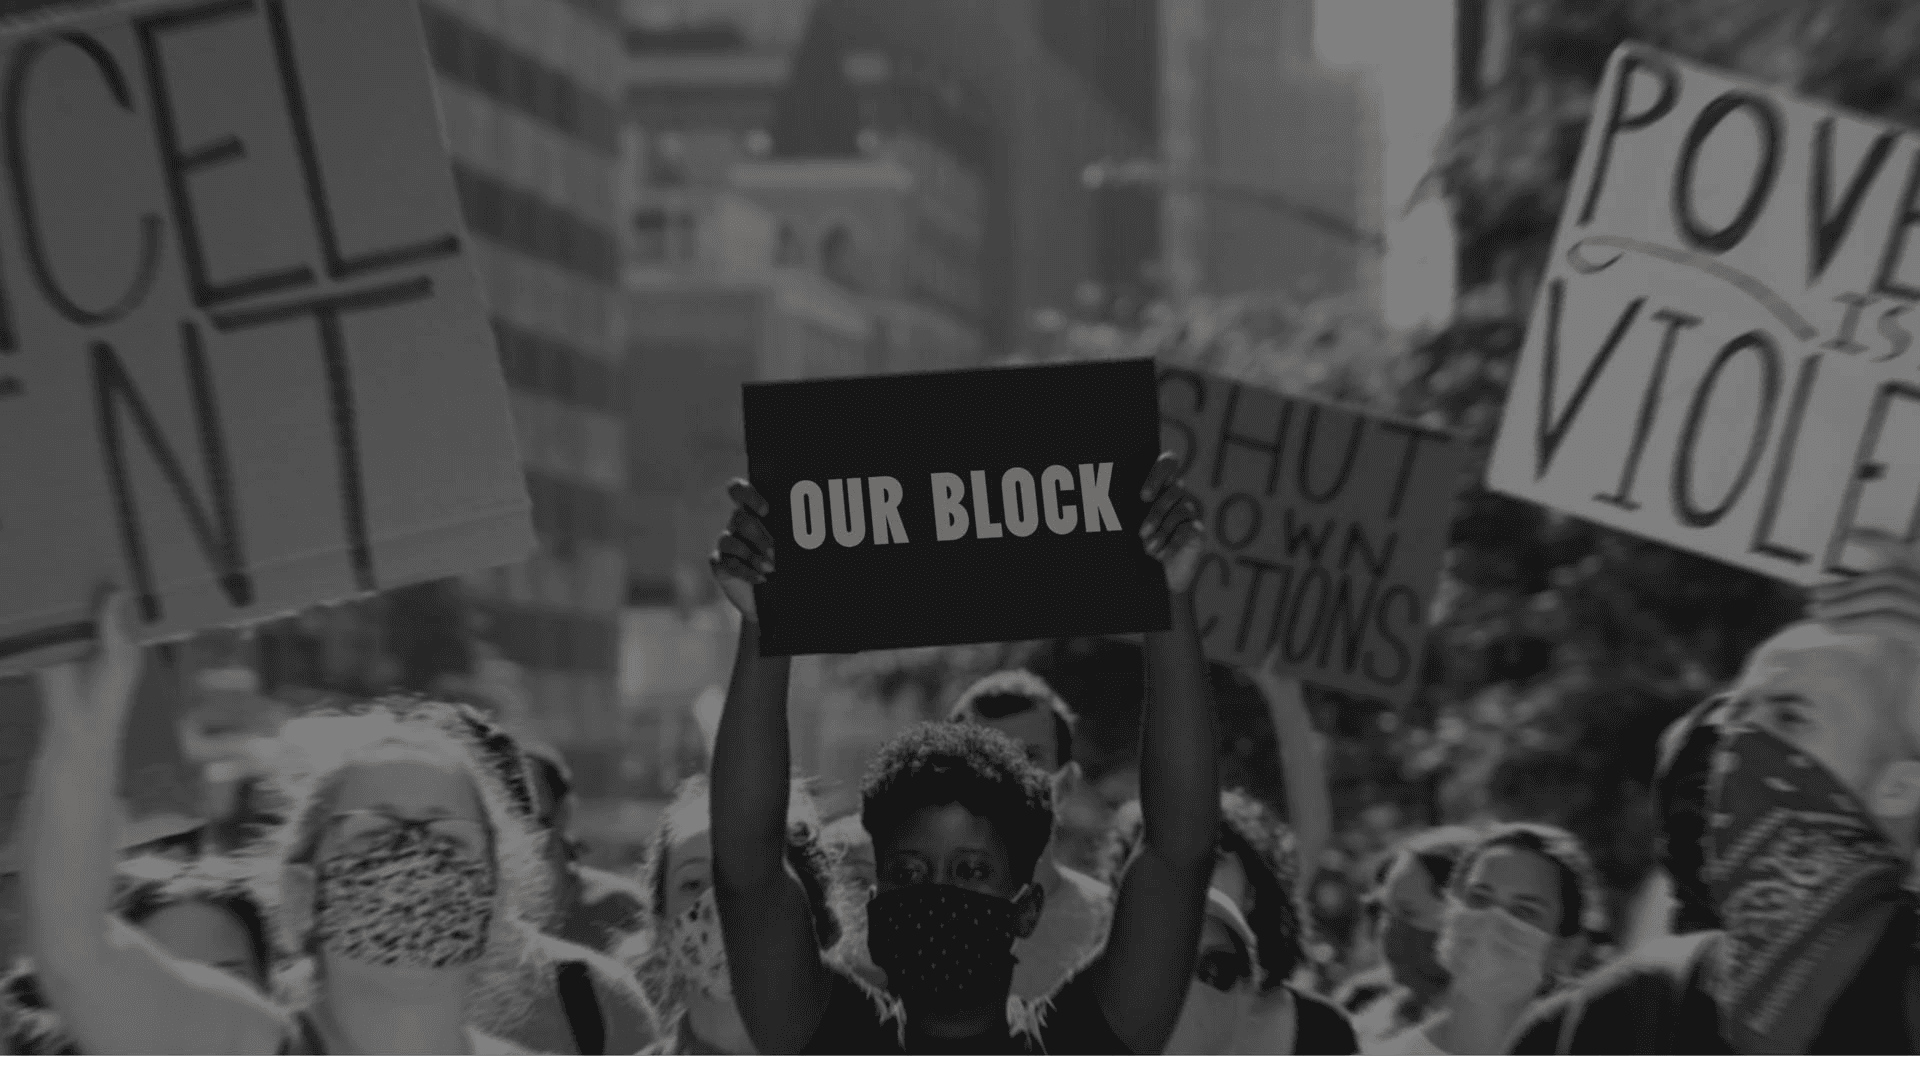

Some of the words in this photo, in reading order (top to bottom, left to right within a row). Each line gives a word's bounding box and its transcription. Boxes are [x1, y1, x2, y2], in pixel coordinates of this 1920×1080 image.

[0, 0, 461, 354] CEL
[1820, 291, 1920, 363] IS
[1157, 366, 1453, 522] SHUT
[1534, 276, 1920, 579] VIOLE
[790, 475, 910, 551] OUR
[930, 461, 1123, 543] BLOCK
